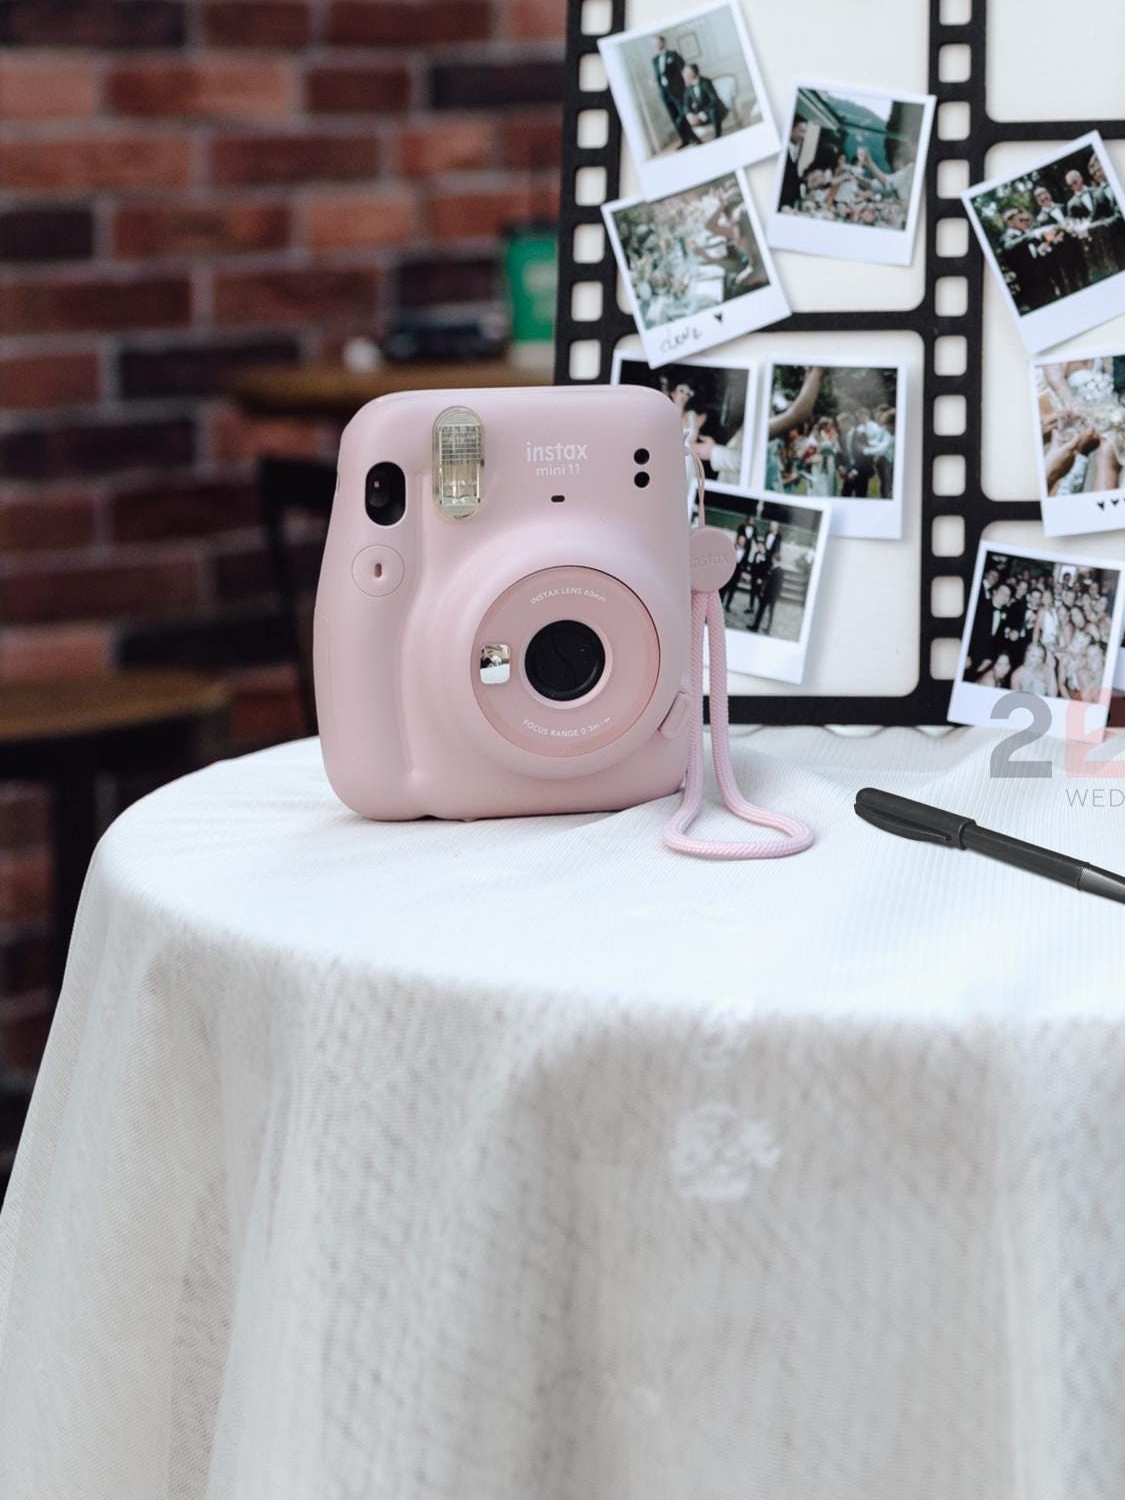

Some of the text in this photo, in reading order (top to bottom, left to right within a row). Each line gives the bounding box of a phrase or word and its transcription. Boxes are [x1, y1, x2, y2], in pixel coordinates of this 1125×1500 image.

[526, 441, 588, 462] instax
[536, 463, 580, 476] mini 11
[530, 589, 559, 604] INSTAX
[561, 587, 582, 595] LENS
